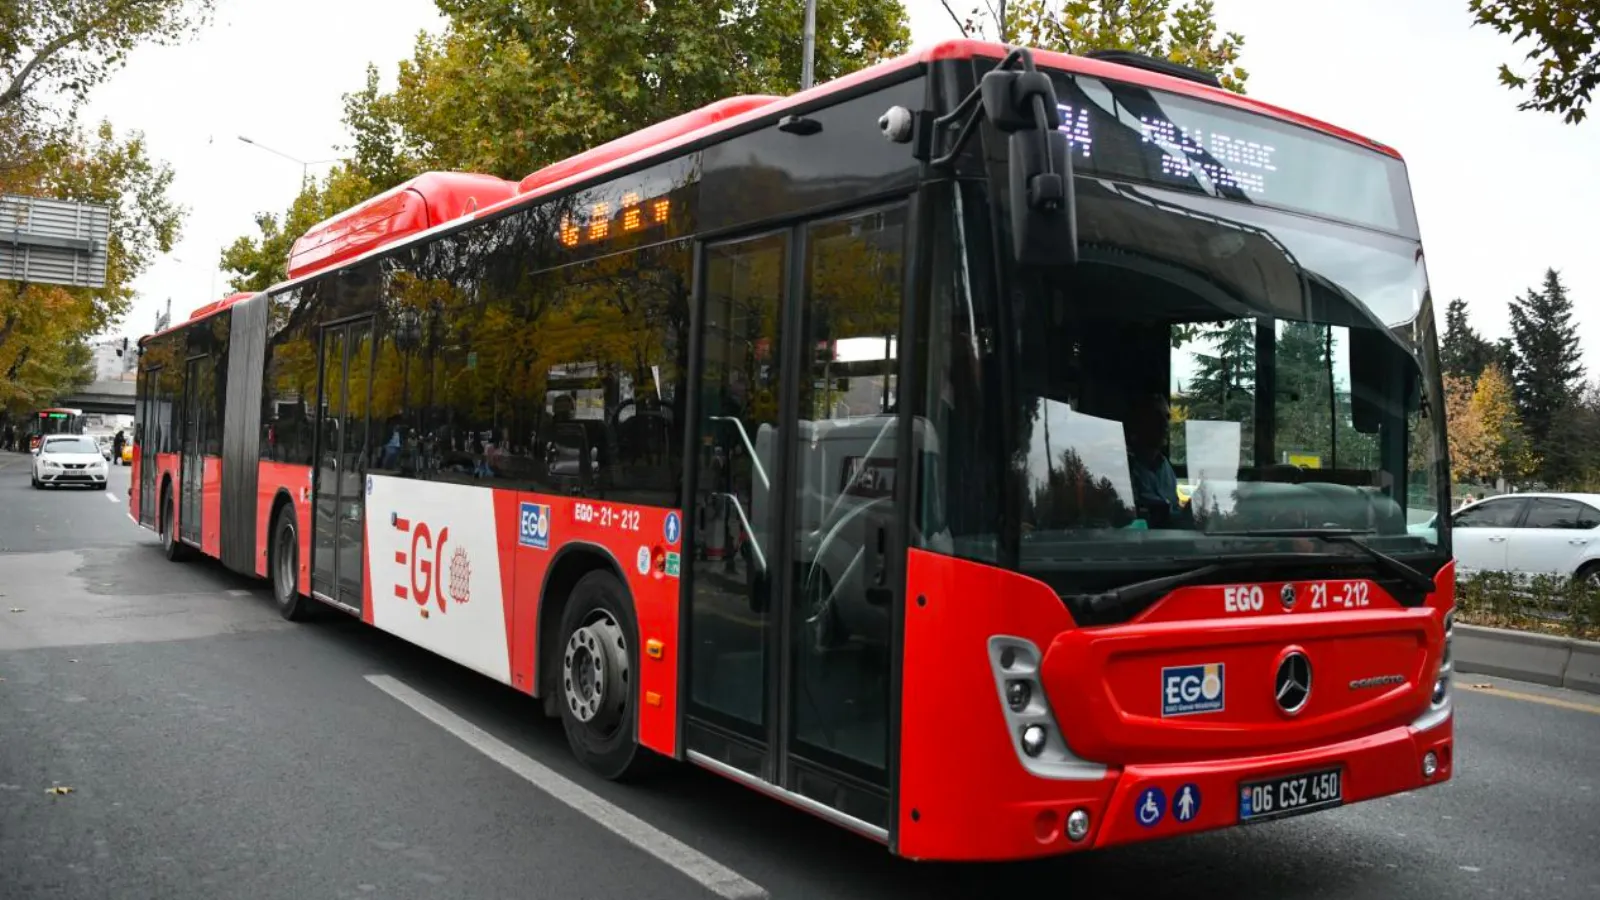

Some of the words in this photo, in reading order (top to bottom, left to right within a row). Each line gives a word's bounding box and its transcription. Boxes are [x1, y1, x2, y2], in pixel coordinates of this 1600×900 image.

[522, 510, 548, 537] EGO
[1224, 586, 1264, 612] EGO
[1166, 674, 1221, 704] EGO
[1252, 784, 1273, 812] 06
[1280, 778, 1308, 808] CSZ
[1312, 772, 1337, 800] 450
